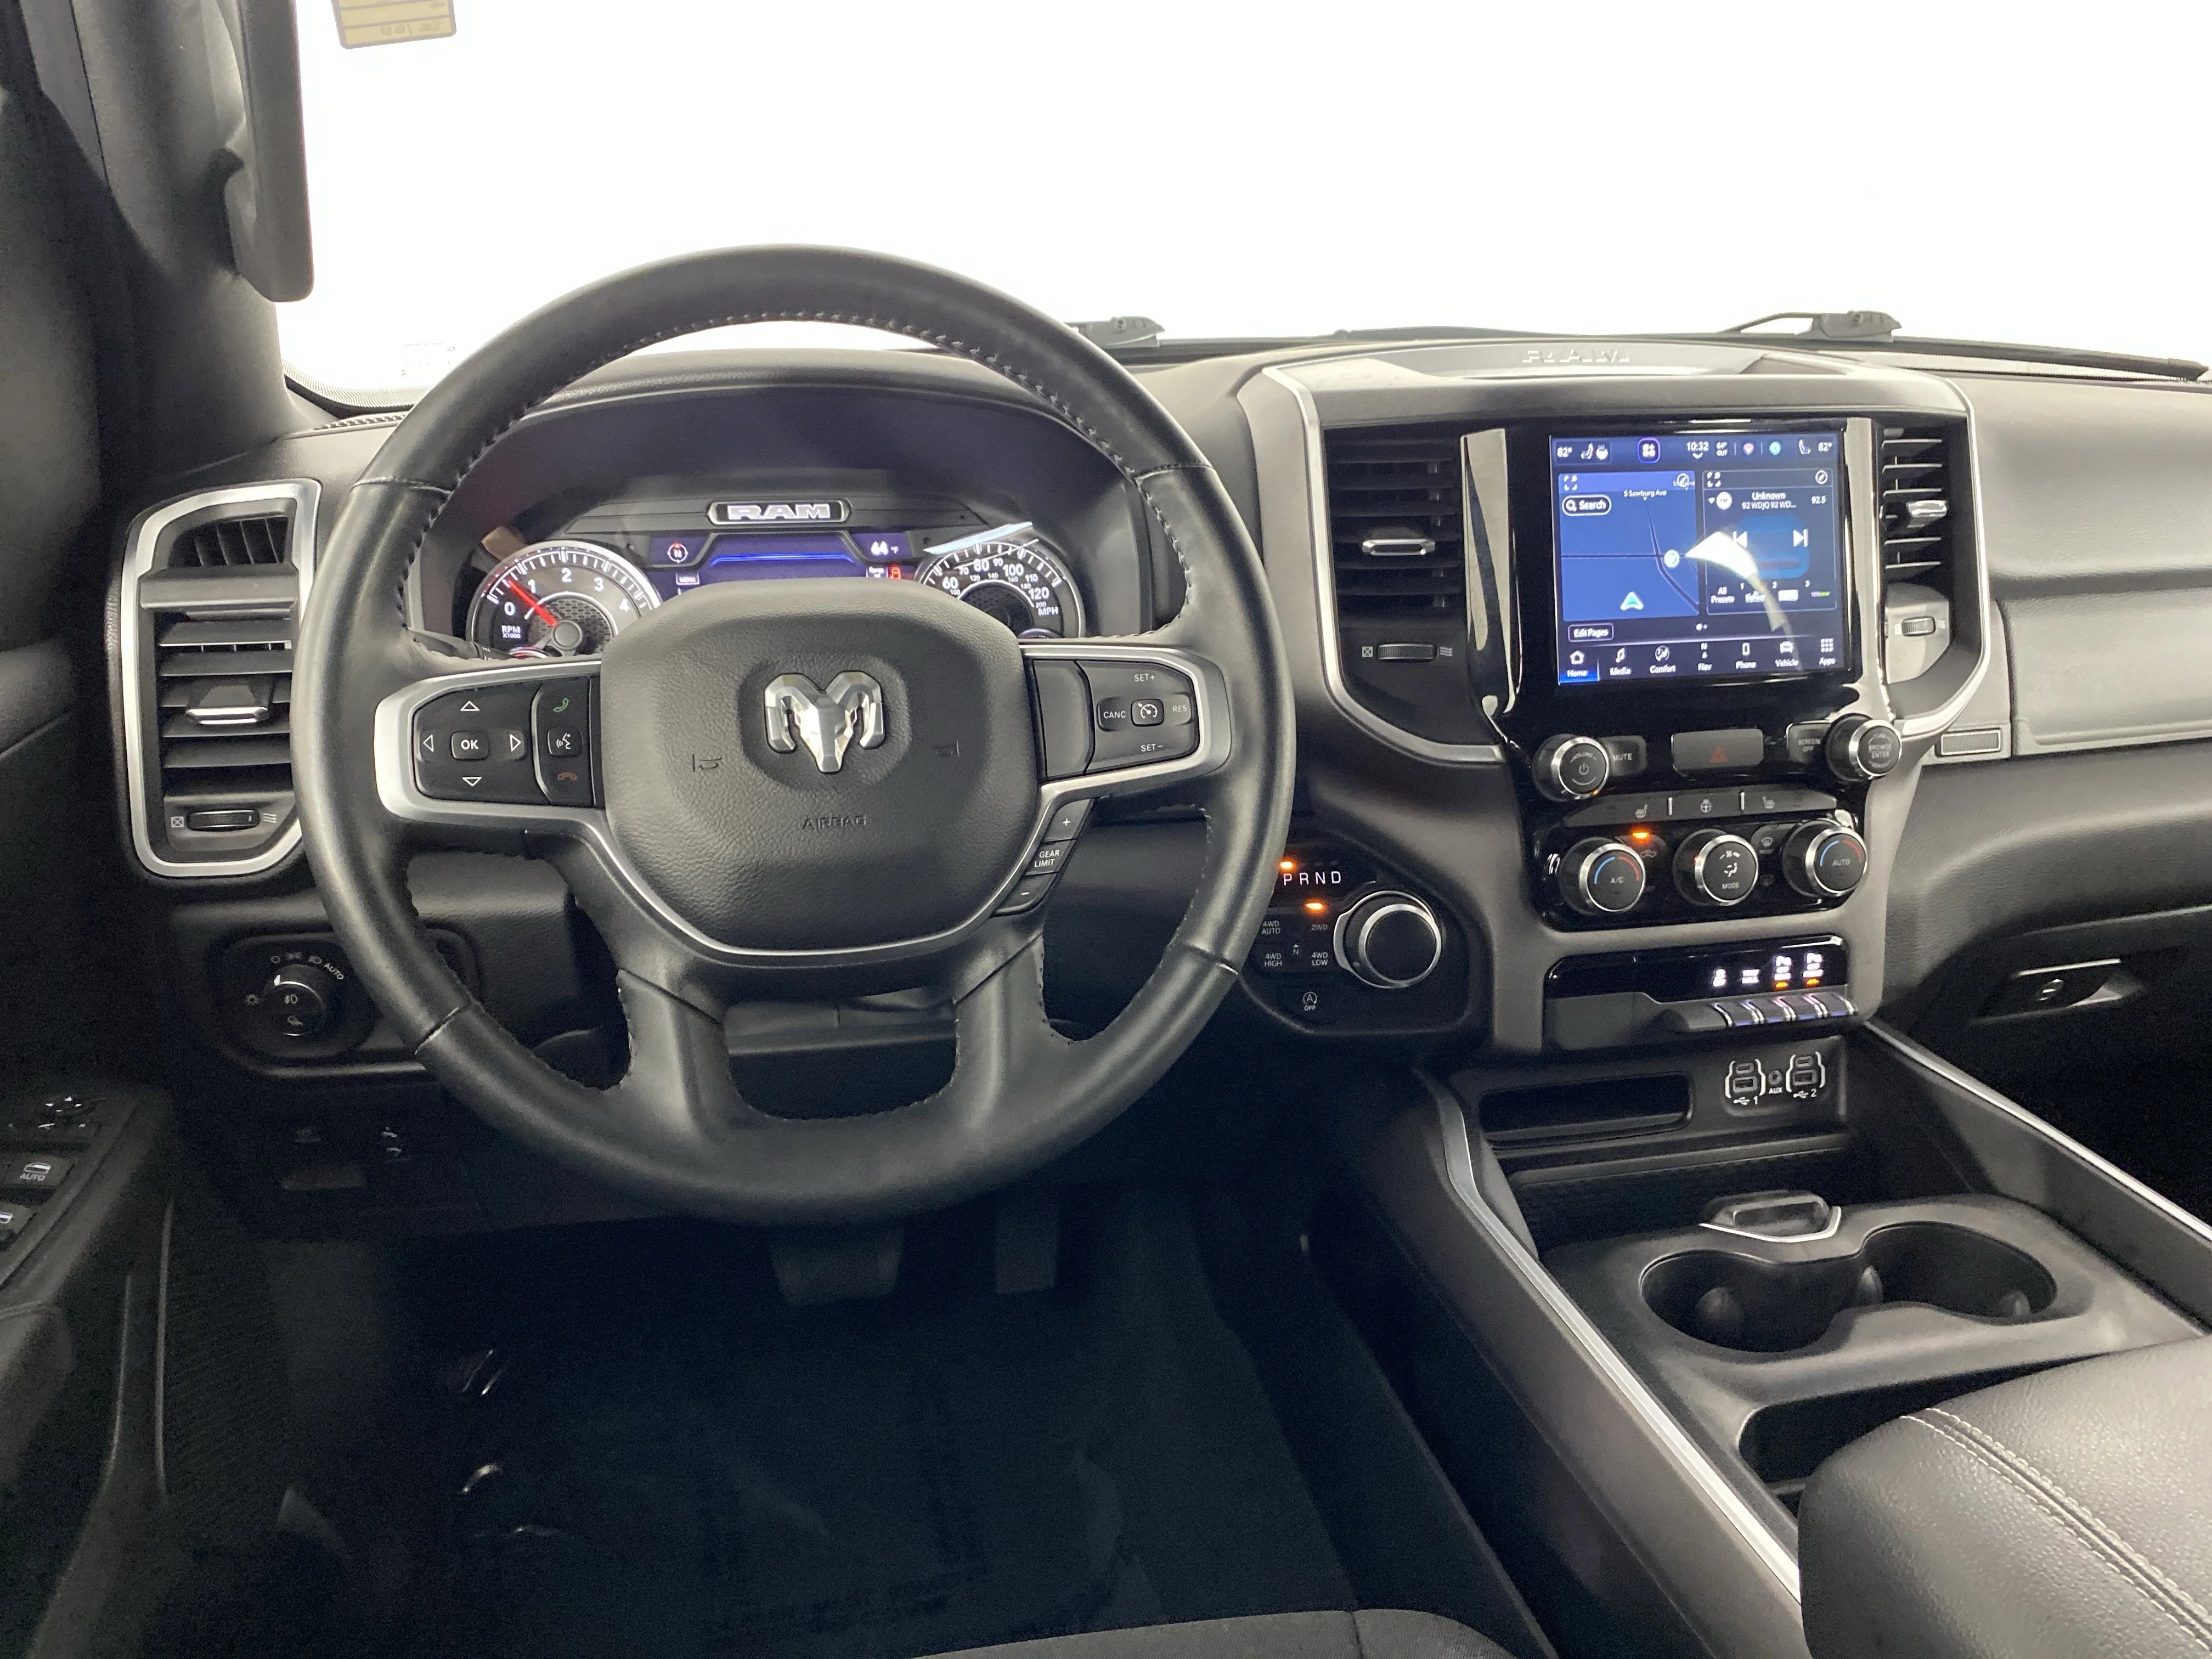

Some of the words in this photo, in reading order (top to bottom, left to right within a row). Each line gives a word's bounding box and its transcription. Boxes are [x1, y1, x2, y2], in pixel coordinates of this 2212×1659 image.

[1686, 441, 1709, 452] 10:32
[1751, 491, 1786, 501] Unknown
[1579, 499, 1606, 510] Search
[727, 503, 830, 521] RAM
[973, 559, 990, 572] 80
[994, 558, 1003, 567] 90
[561, 567, 572, 583] 2
[1003, 563, 1024, 577] 100
[528, 579, 537, 594] 1
[594, 577, 605, 591] 3
[942, 577, 958, 590] 60
[1029, 587, 1050, 600] 120
[504, 601, 516, 616] 0
[619, 598, 630, 612] 4
[1038, 606, 1058, 616] MPH
[501, 625, 521, 634] RPM
[1735, 661, 1756, 669] Phone
[1818, 657, 1836, 667] Apps
[1610, 667, 1631, 676] Media
[1172, 704, 1188, 713] RES
[1103, 710, 1126, 719] CANC
[460, 739, 479, 751] OK
[1612, 753, 1633, 761] MUTE
[1039, 849, 1060, 858] GEAR
[1034, 858, 1055, 868] LIMIT
[1832, 858, 1851, 866] AUTO
[1283, 873, 1293, 887] P
[1299, 872, 1309, 885] R
[1315, 871, 1326, 884] N
[1331, 871, 1341, 884] D
[1610, 876, 1624, 884] A/C
[1722, 882, 1740, 890] MODE
[324, 963, 345, 980] AUTO
[1768, 1086, 1783, 1094] AUX
[1810, 1088, 1818, 1098] 2
[1753, 1095, 1758, 1105] 1
